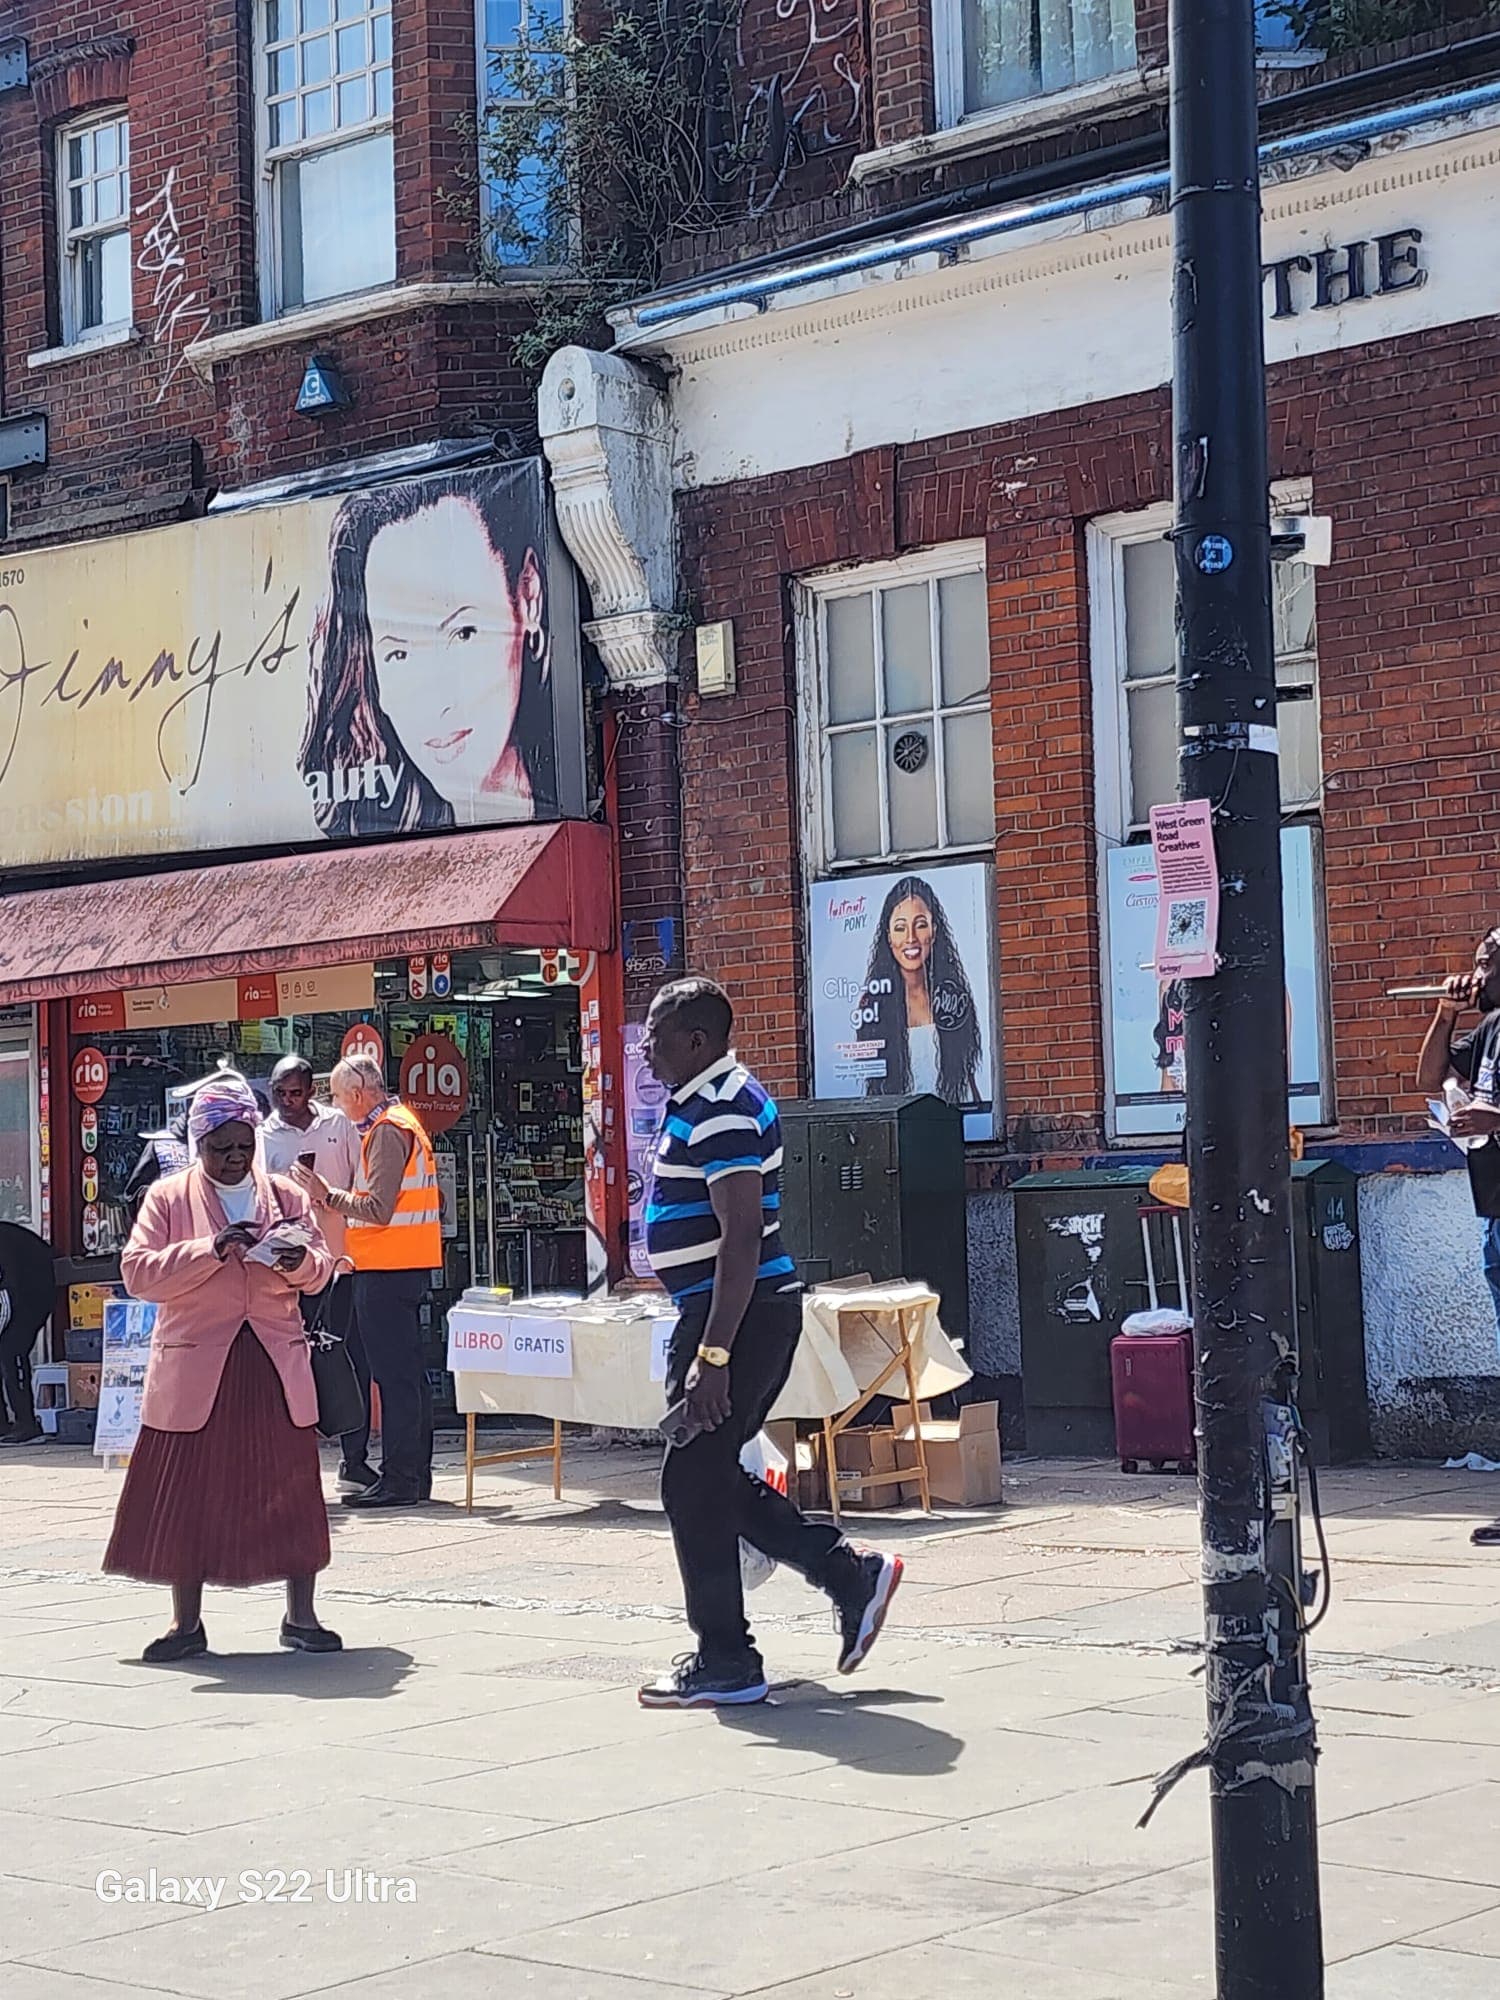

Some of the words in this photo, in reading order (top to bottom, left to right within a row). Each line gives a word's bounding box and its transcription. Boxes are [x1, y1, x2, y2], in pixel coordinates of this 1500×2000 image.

[1261, 229, 1429, 319] THE
[0, 568, 25, 588] 670
[1155, 819, 1178, 831] West
[1179, 817, 1206, 828] Green
[1156, 830, 1179, 842] Road
[1158, 840, 1201, 853] Creatives
[844, 914, 868, 933] PONY
[244, 986, 260, 1001] ria
[824, 978, 892, 1002] Clip-on
[78, 999, 97, 1018] ria
[850, 1001, 880, 1030] go!
[75, 1054, 104, 1083] ria
[408, 1046, 461, 1097] ria
[433, 1100, 461, 1111] Transfer
[454, 1331, 504, 1351] LIBRO
[514, 1336, 565, 1354] GRATIS
